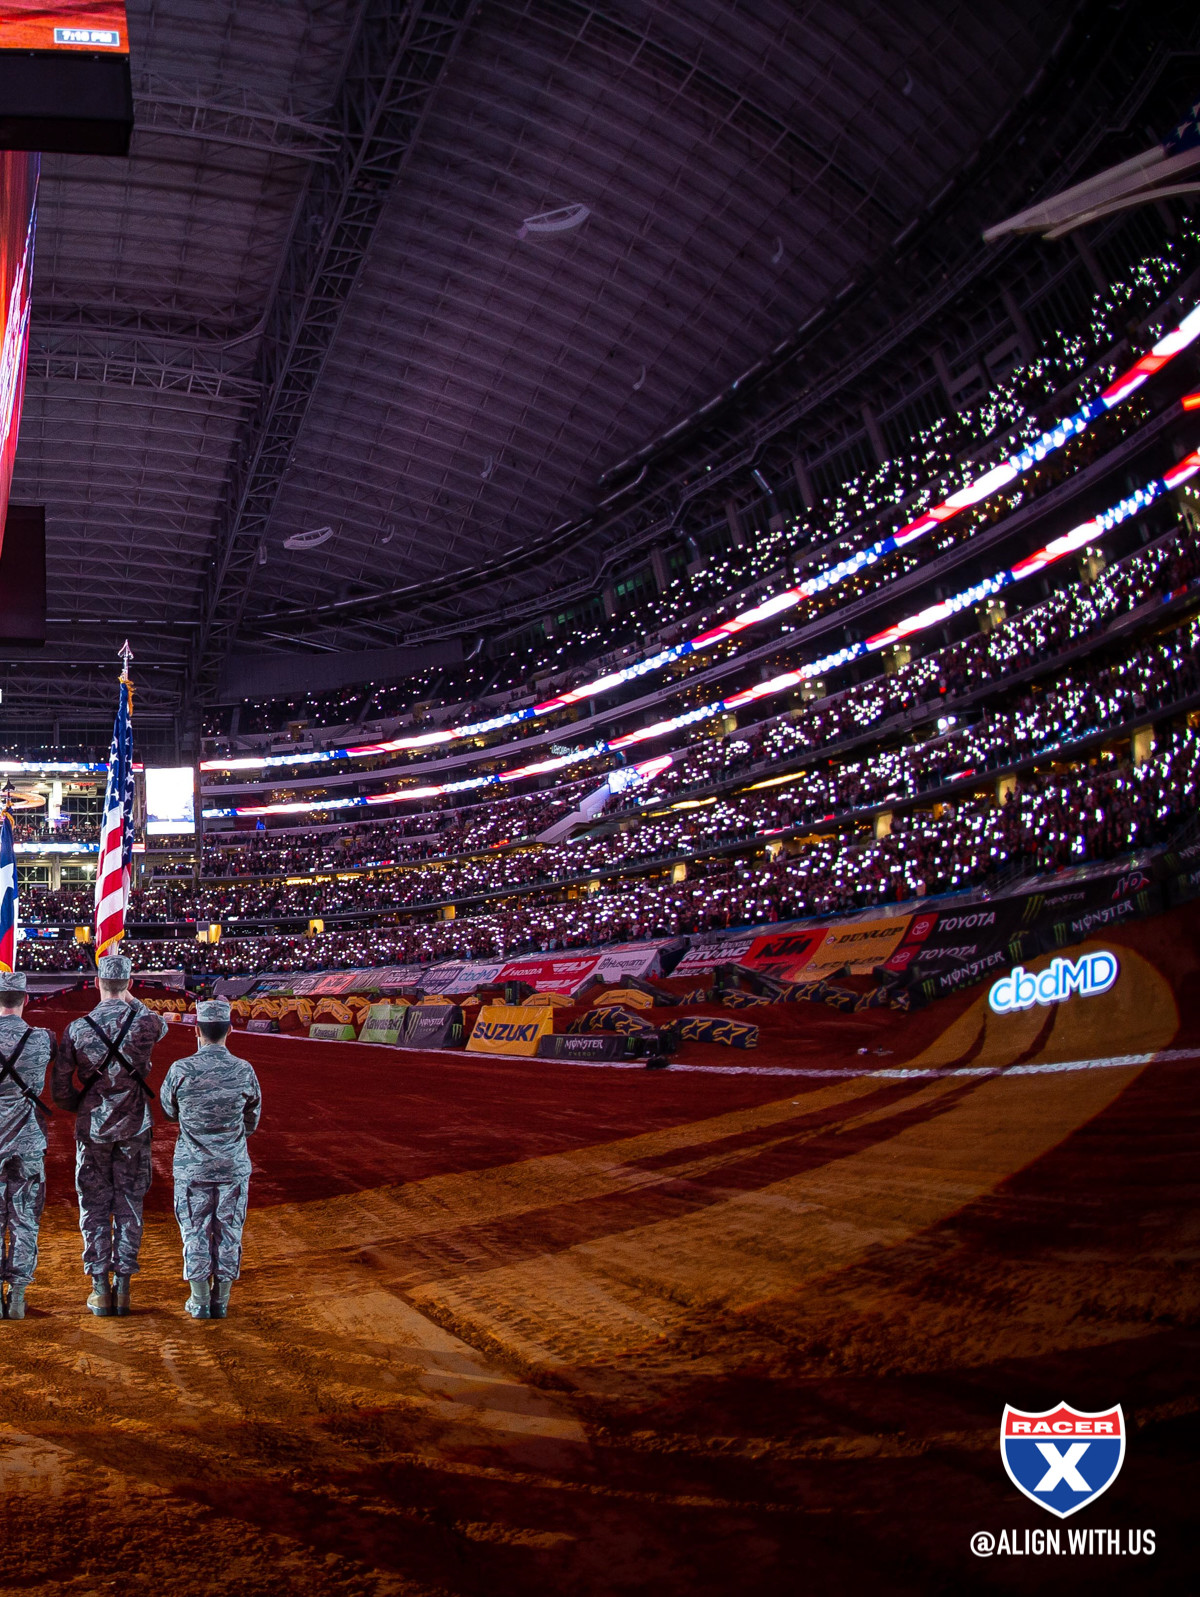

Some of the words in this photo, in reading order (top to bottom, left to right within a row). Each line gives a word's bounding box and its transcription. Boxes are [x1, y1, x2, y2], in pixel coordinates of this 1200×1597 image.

[937, 912, 996, 932] TOYOTA
[1071, 900, 1135, 932] MONSTER
[838, 926, 905, 944] DUNLOP
[755, 935, 813, 959] KTM
[917, 944, 978, 961] TOYOTA
[552, 960, 596, 972] FLY
[608, 957, 646, 969] Husqvarna
[940, 951, 1006, 988] MONSTER
[458, 968, 499, 981] cbdMD
[510, 967, 542, 976] HONDA
[991, 952, 1116, 1011] cbdMD
[366, 1015, 404, 1031] Kawasaki
[419, 1017, 444, 1027] MONSTER
[314, 1027, 339, 1037] Kawasaki
[472, 1021, 540, 1042] SUZUKI
[565, 1038, 604, 1050] MONSTER
